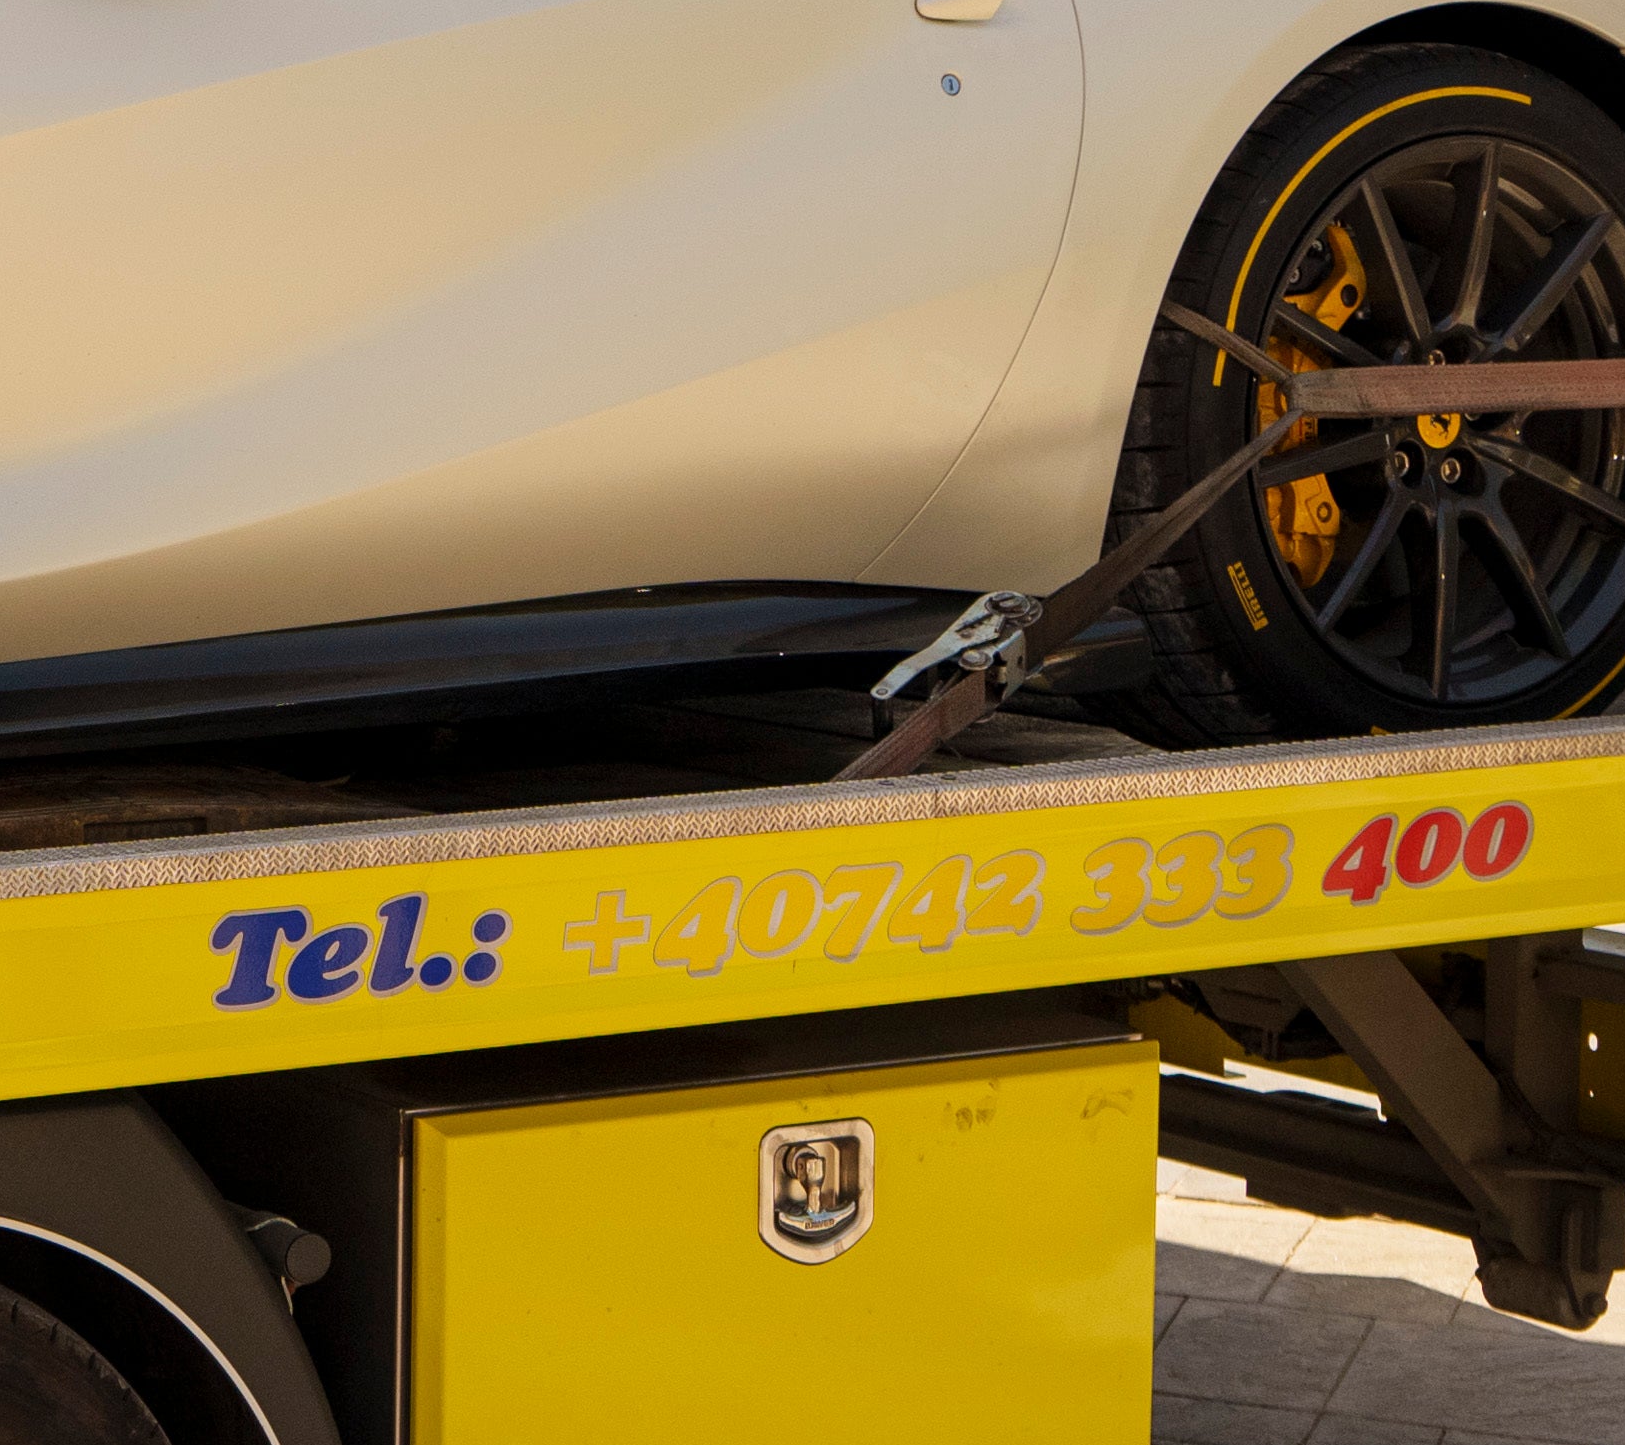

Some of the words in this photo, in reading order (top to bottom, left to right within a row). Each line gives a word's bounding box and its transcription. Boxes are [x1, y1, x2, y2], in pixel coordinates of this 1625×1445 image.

[1226, 561, 1269, 632] PIRELLI
[209, 890, 513, 1012] Tel.:
[562, 849, 1047, 979] +40742
[1069, 822, 1296, 936] 333
[1320, 799, 1535, 907] 400
